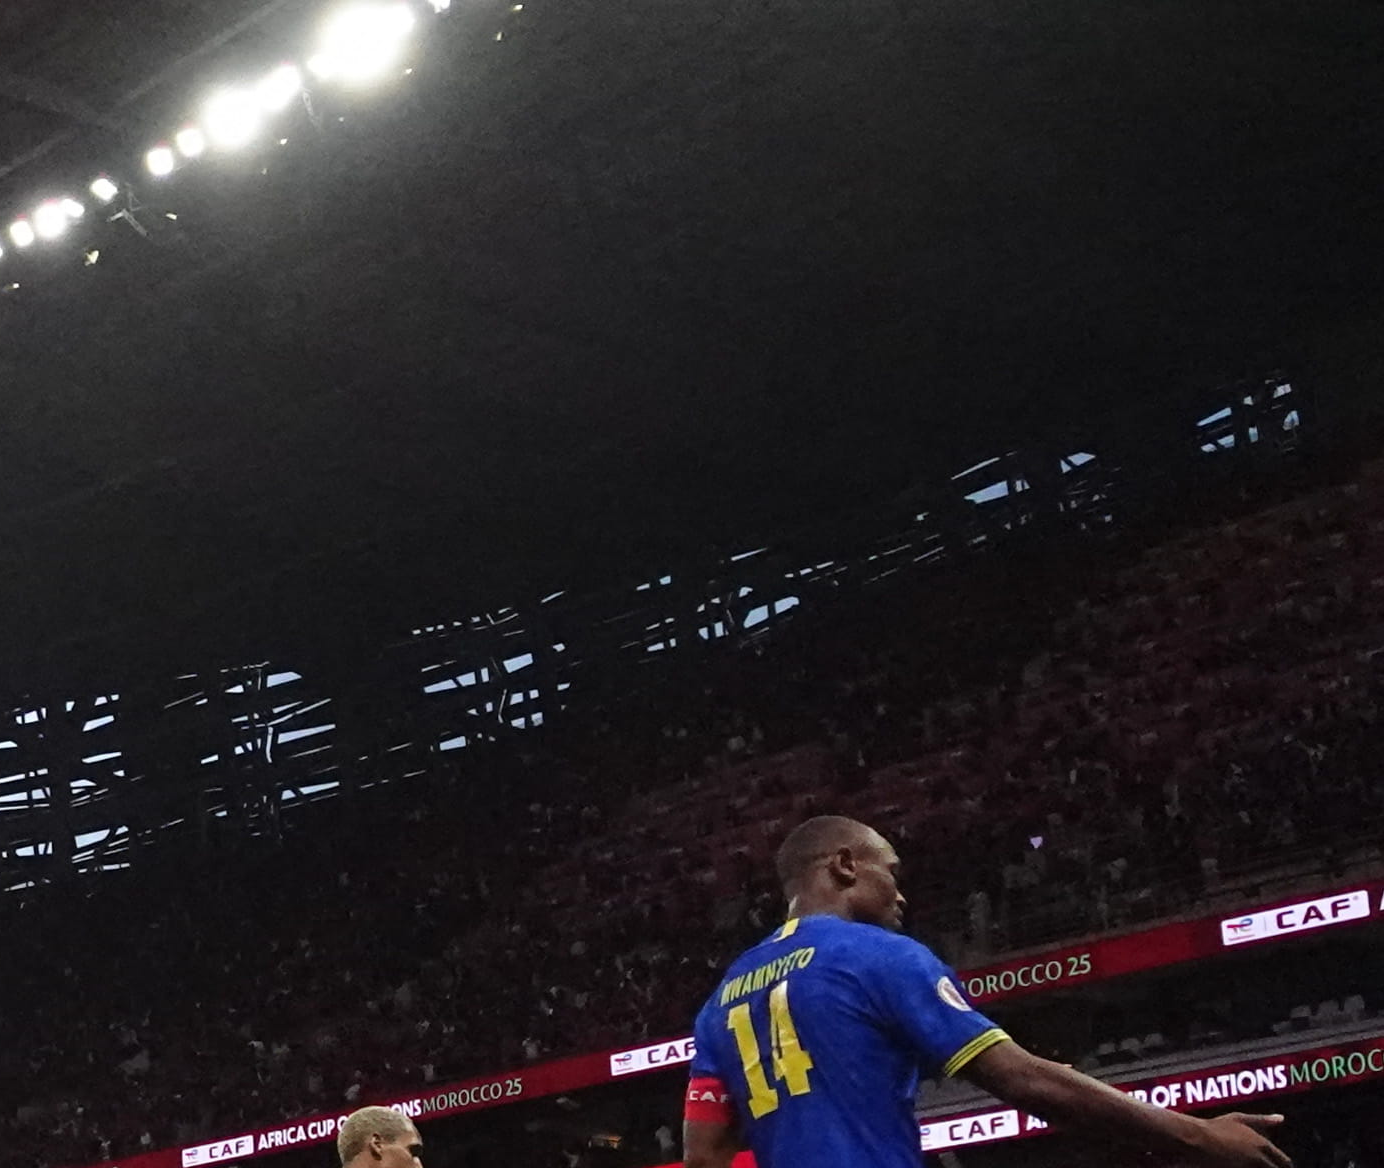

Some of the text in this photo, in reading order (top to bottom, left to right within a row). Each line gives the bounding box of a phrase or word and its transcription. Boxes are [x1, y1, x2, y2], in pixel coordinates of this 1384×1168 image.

[1276, 898, 1351, 930] CAF
[961, 953, 1092, 997] OROCCO 25
[647, 1041, 697, 1064] CAF
[727, 980, 814, 1119] 14
[422, 1082, 503, 1114] MOROCCO
[505, 1078, 523, 1097] 25
[1151, 1048, 1384, 1108] OF NATIONS MOROC
[209, 1139, 246, 1159] CAF
[257, 1124, 307, 1151] AFRICA
[307, 1118, 336, 1140] CUP
[949, 1116, 1005, 1141] CAF
